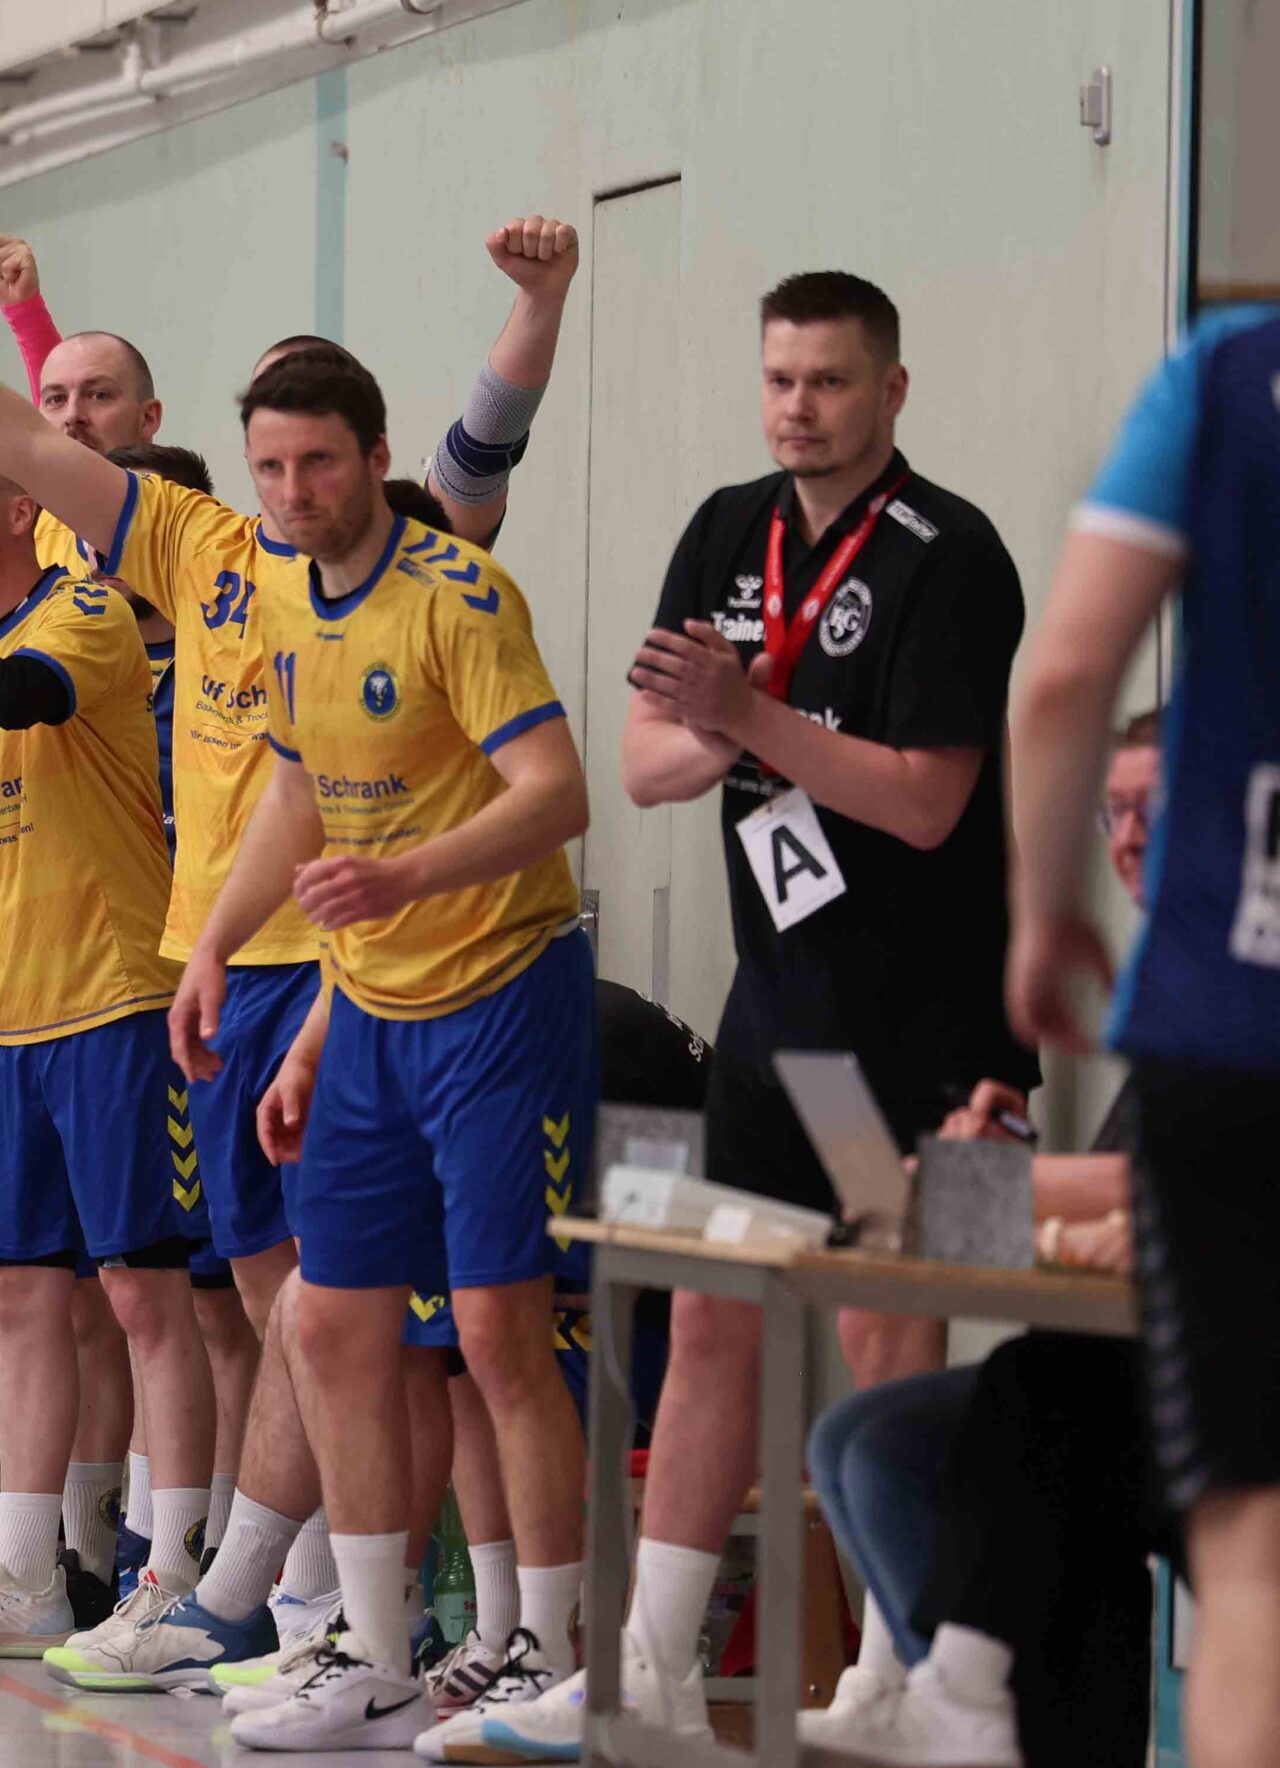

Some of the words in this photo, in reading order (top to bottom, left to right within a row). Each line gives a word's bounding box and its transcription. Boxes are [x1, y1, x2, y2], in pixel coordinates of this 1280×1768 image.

[201, 570, 256, 640] 34
[318, 773, 408, 798] Schrank
[770, 825, 828, 904] A
